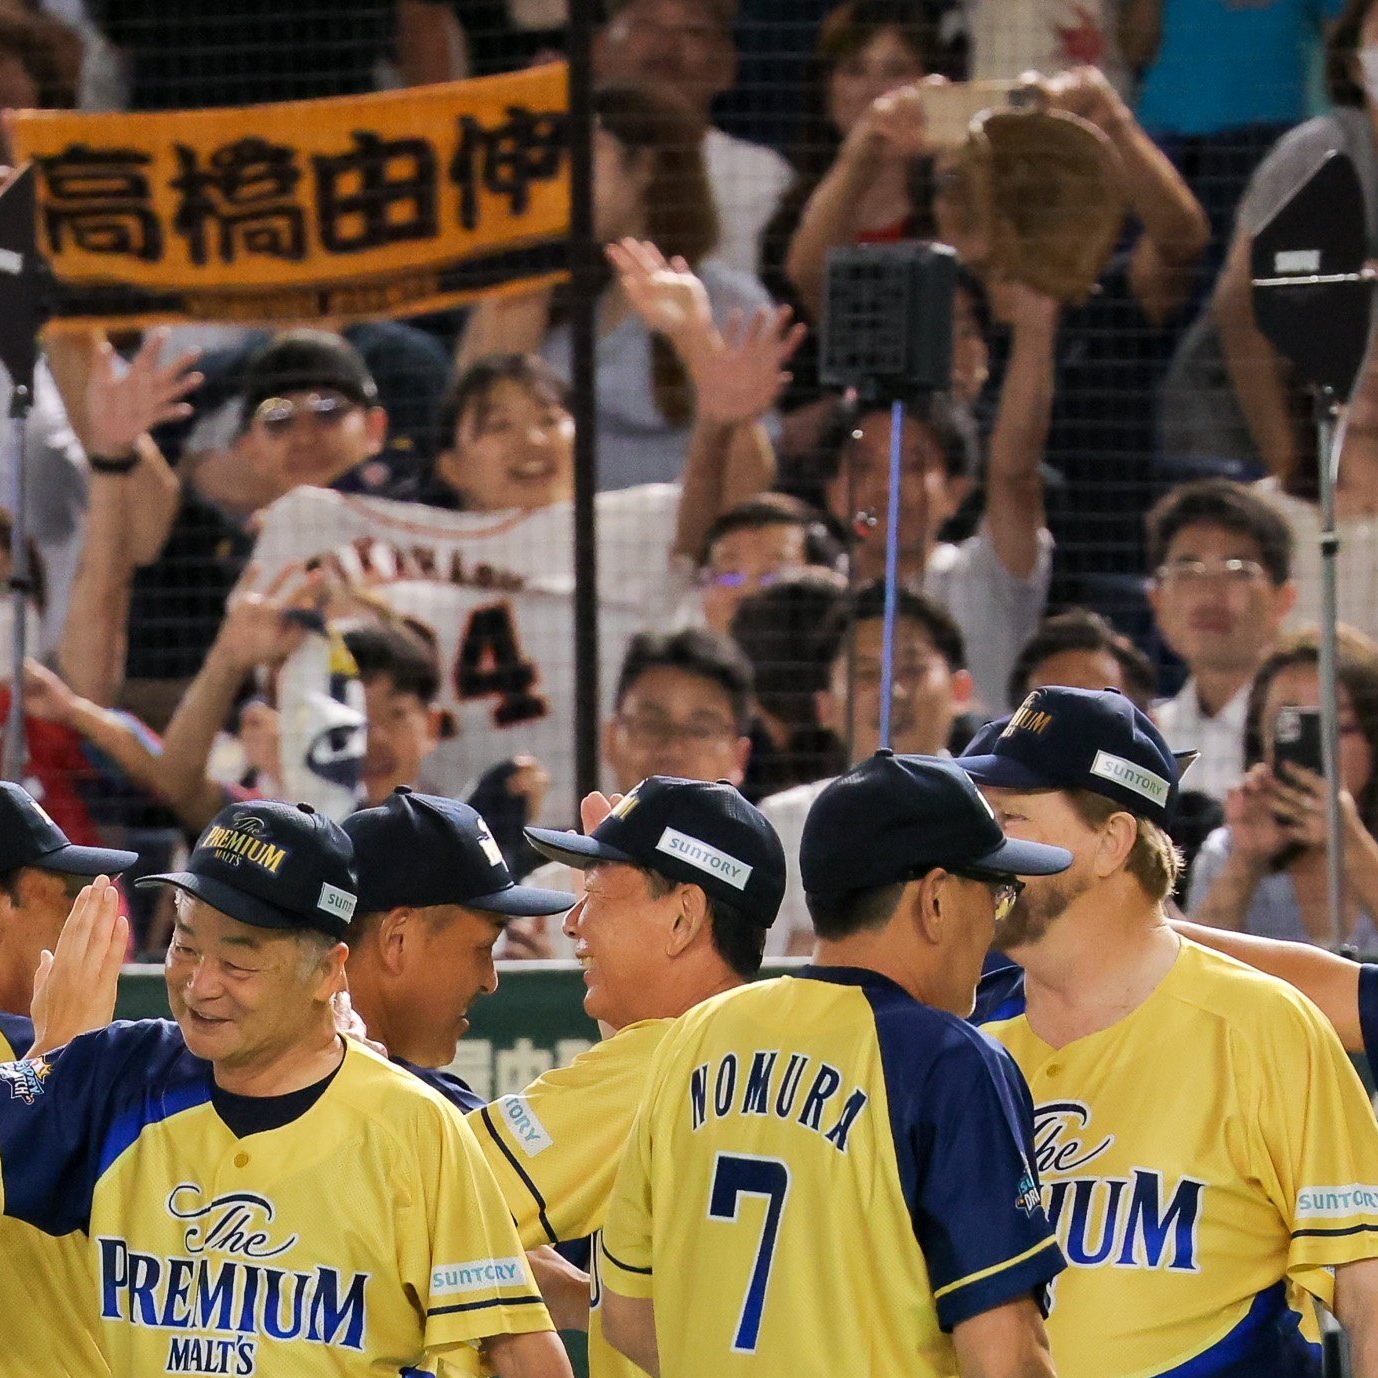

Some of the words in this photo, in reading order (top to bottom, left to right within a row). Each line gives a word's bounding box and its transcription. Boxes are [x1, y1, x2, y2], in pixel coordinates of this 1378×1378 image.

[32, 107, 570, 265] 高橋由伸
[428, 600, 551, 736] 4
[1105, 760, 1163, 797] SUNTORY
[202, 825, 286, 873] PREMIUM
[668, 837, 742, 879] SUNTORY
[690, 1050, 869, 1153] NOMURA
[165, 1182, 299, 1258] The
[707, 1151, 792, 1355] 7
[97, 1235, 370, 1352] PREMIUM
[434, 1263, 517, 1288] SUNTORY
[165, 1335, 256, 1377] MALT'S
